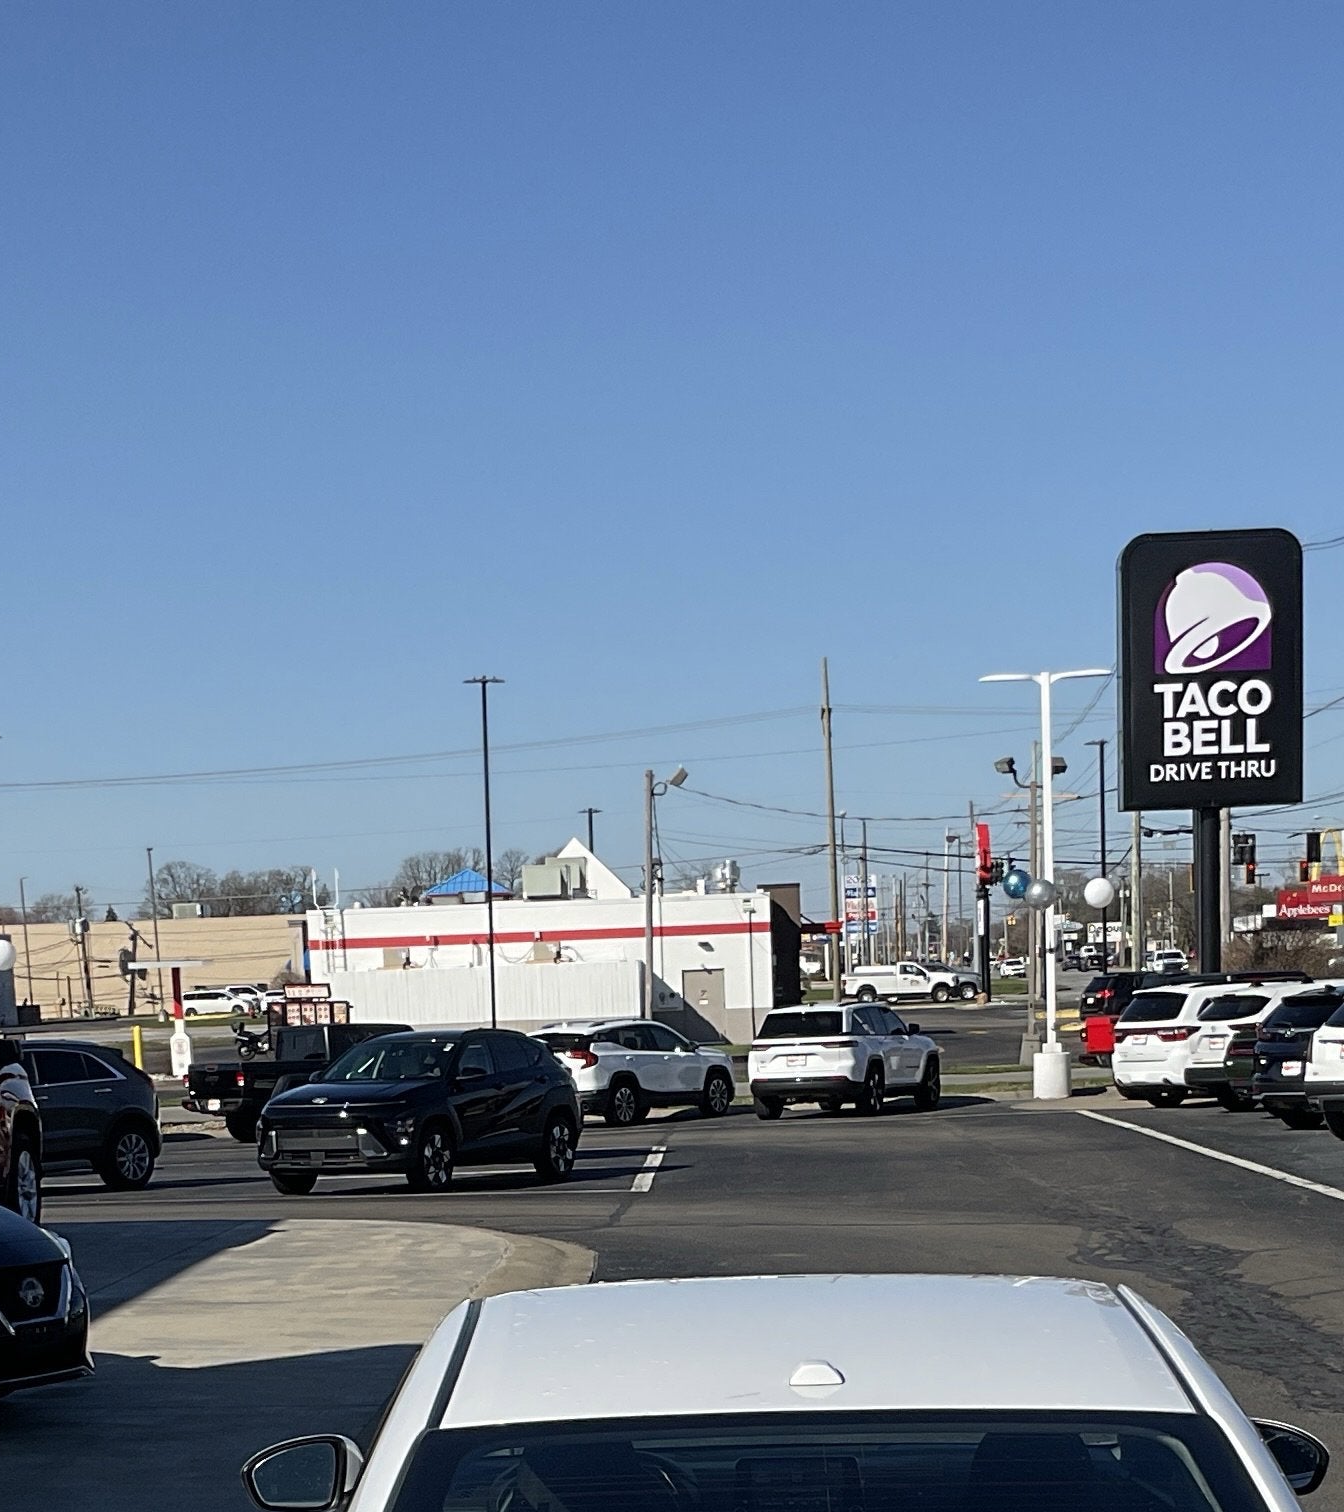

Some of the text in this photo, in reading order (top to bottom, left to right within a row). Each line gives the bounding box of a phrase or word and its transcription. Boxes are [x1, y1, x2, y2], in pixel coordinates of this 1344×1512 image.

[1153, 679, 1272, 719] TACO
[1163, 718, 1270, 757] BELL
[1149, 759, 1276, 782] DRIVE THRU
[1278, 904, 1331, 918] Applebee's
